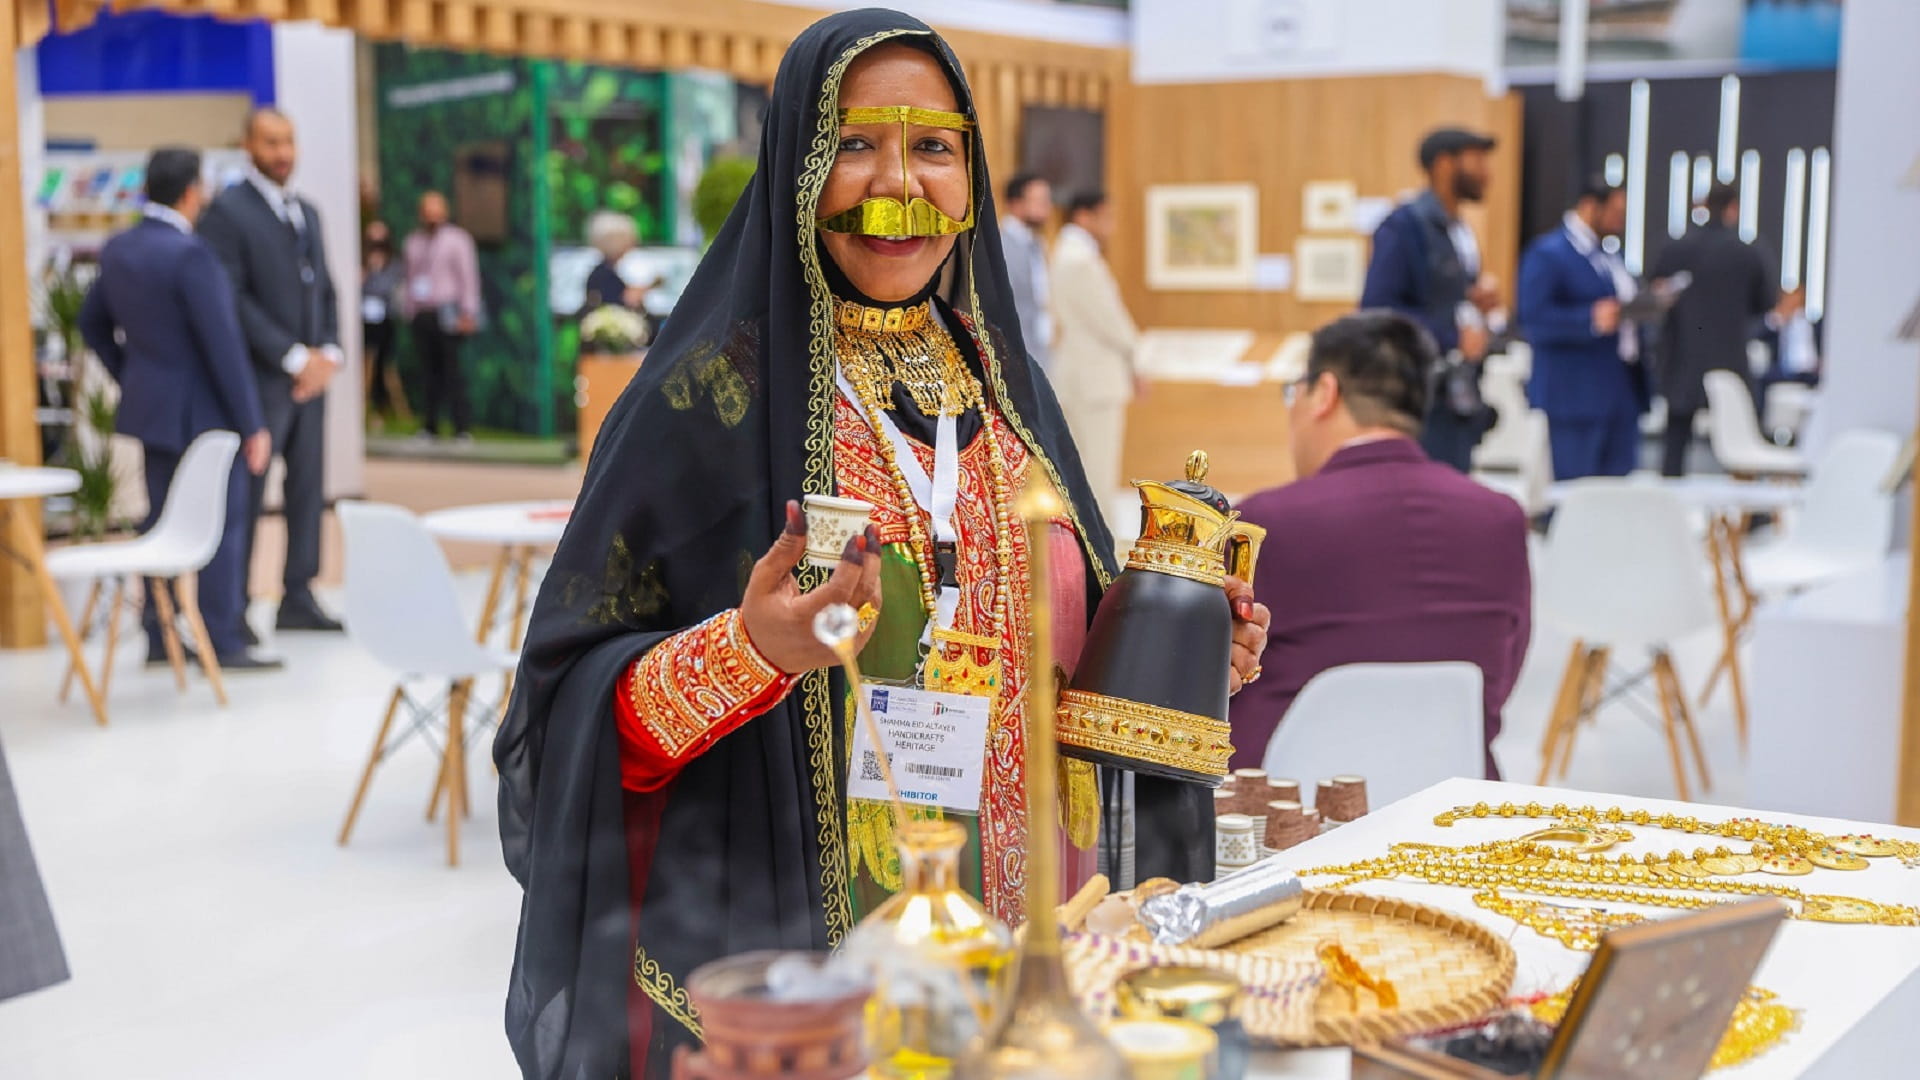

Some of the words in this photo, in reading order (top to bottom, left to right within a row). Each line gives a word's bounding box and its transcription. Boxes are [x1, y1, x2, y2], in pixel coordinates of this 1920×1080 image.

[912, 720, 925, 728] EID
[888, 729, 945, 743] HANDICRAFTS
[895, 740, 937, 752] HERITAGE
[890, 789, 938, 801] HIBITOR
